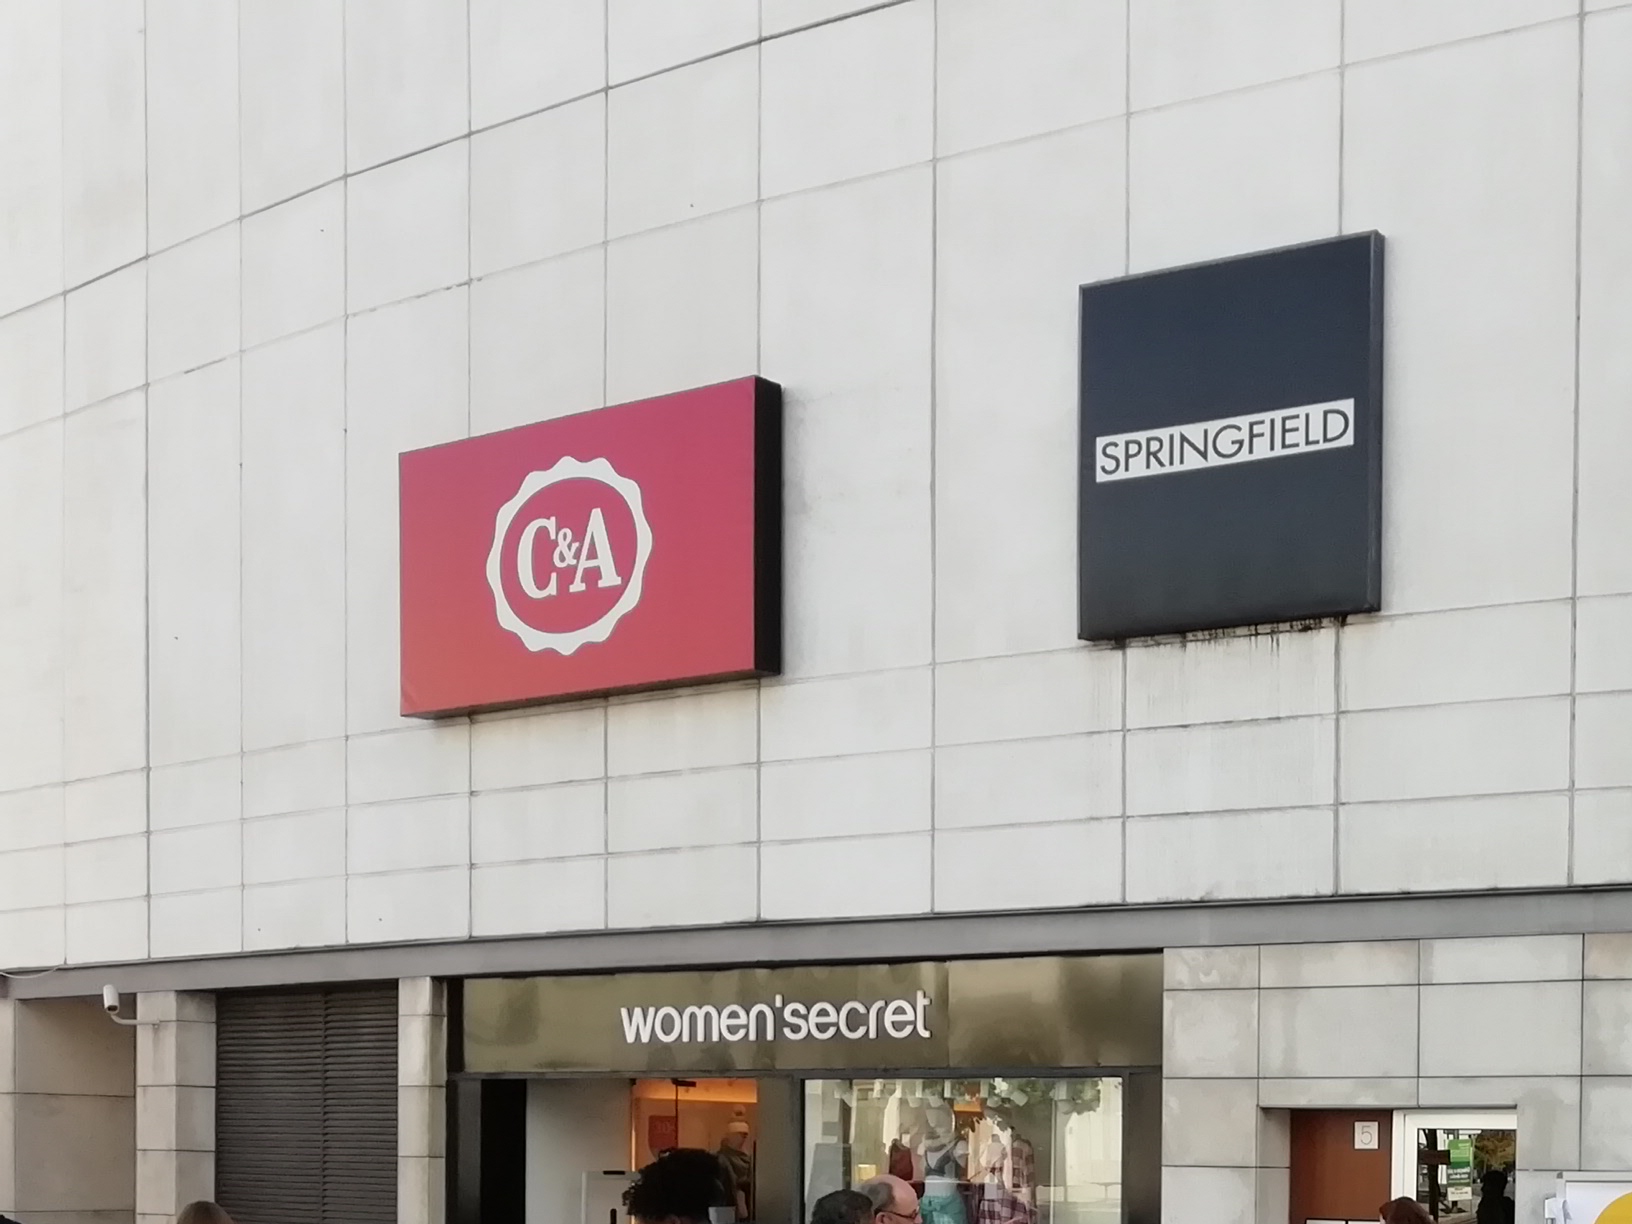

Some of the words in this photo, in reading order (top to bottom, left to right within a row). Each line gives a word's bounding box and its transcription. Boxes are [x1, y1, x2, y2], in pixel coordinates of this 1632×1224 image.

[1099, 408, 1351, 476] SPRINGFIELD
[516, 507, 623, 599] C&A
[620, 989, 932, 1044] women'secret
[1360, 1124, 1373, 1146] 5
